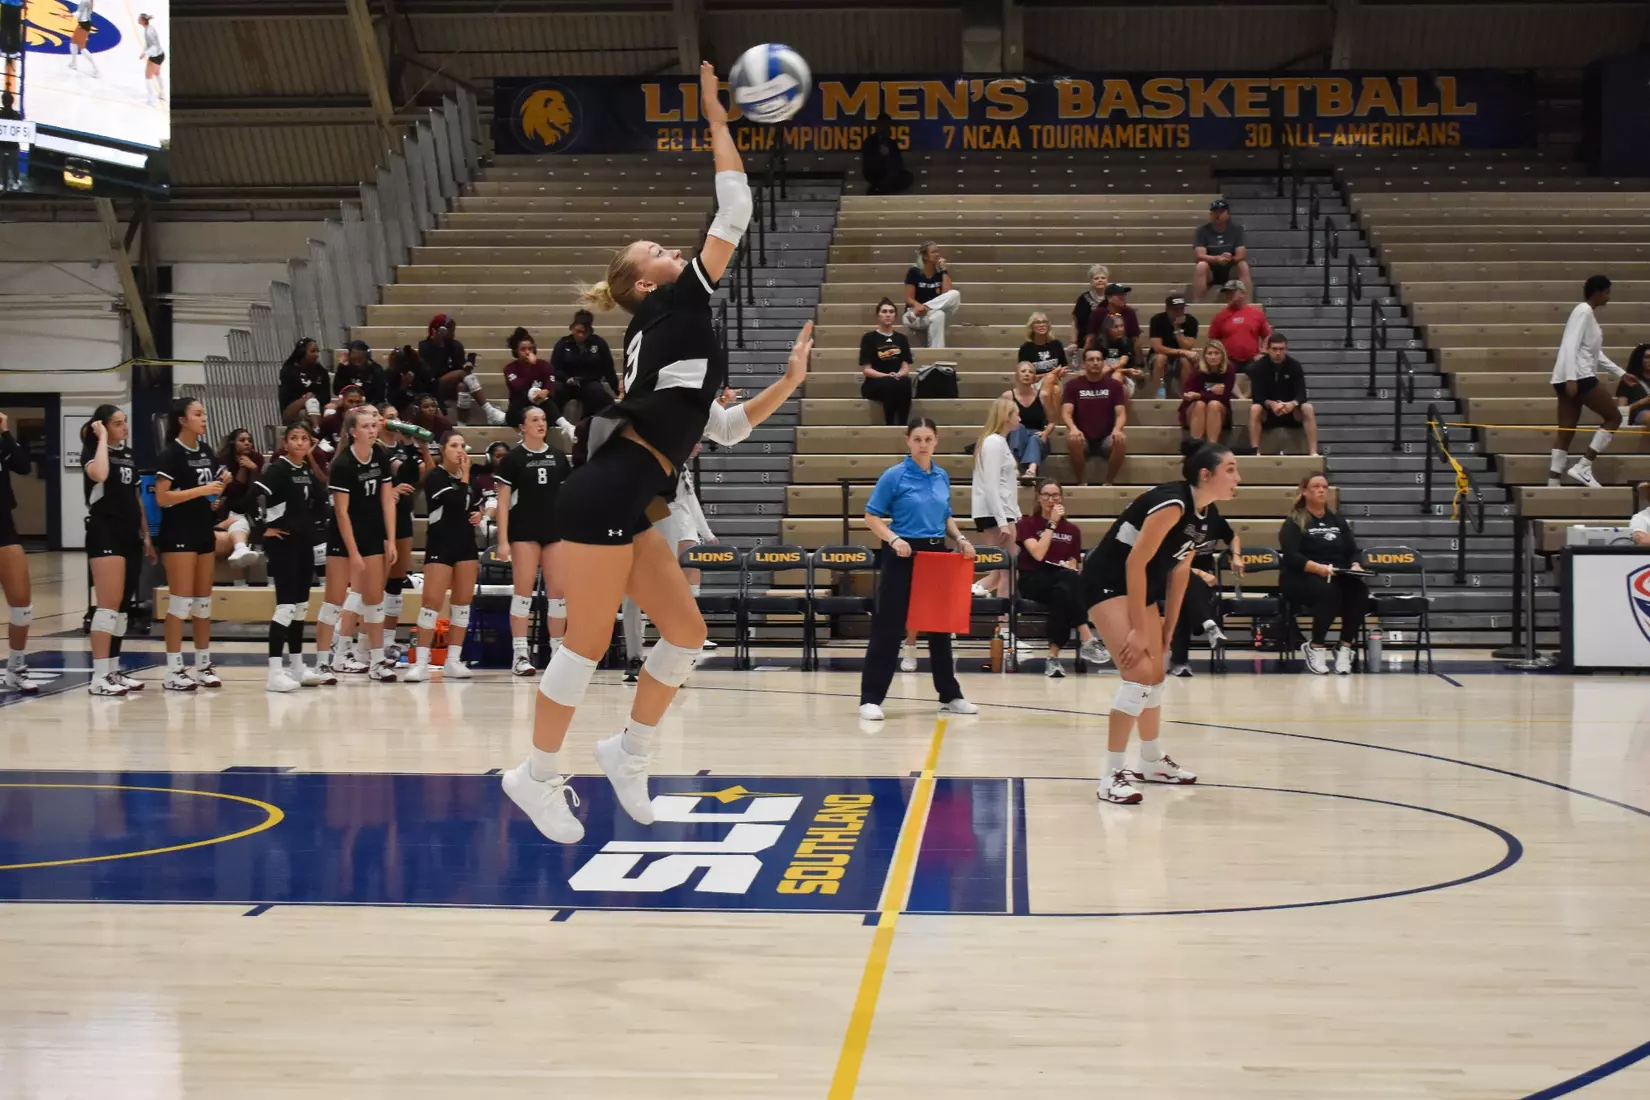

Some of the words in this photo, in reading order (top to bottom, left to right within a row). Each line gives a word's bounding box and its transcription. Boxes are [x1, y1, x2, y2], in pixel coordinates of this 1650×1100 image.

[818, 79, 1029, 121] MEN'S
[1055, 75, 1478, 119] BASKETBALL
[943, 125, 956, 149] 7
[963, 125, 1022, 149] NCAA
[1029, 123, 1191, 149] TOURNAMENTS
[1245, 123, 1272, 147] 30
[1282, 121, 1462, 148] ALL-AMERICANS
[120, 466, 133, 484] 18
[196, 467, 213, 485] 20
[537, 467, 548, 485] 8
[364, 480, 377, 496] 17
[689, 552, 734, 562] LIONS
[755, 552, 800, 562] LIONS
[821, 552, 867, 562] LIONS
[974, 553, 1004, 564] ONS
[1367, 553, 1416, 564] LIONS
[776, 793, 875, 895] SOUTHLAND
